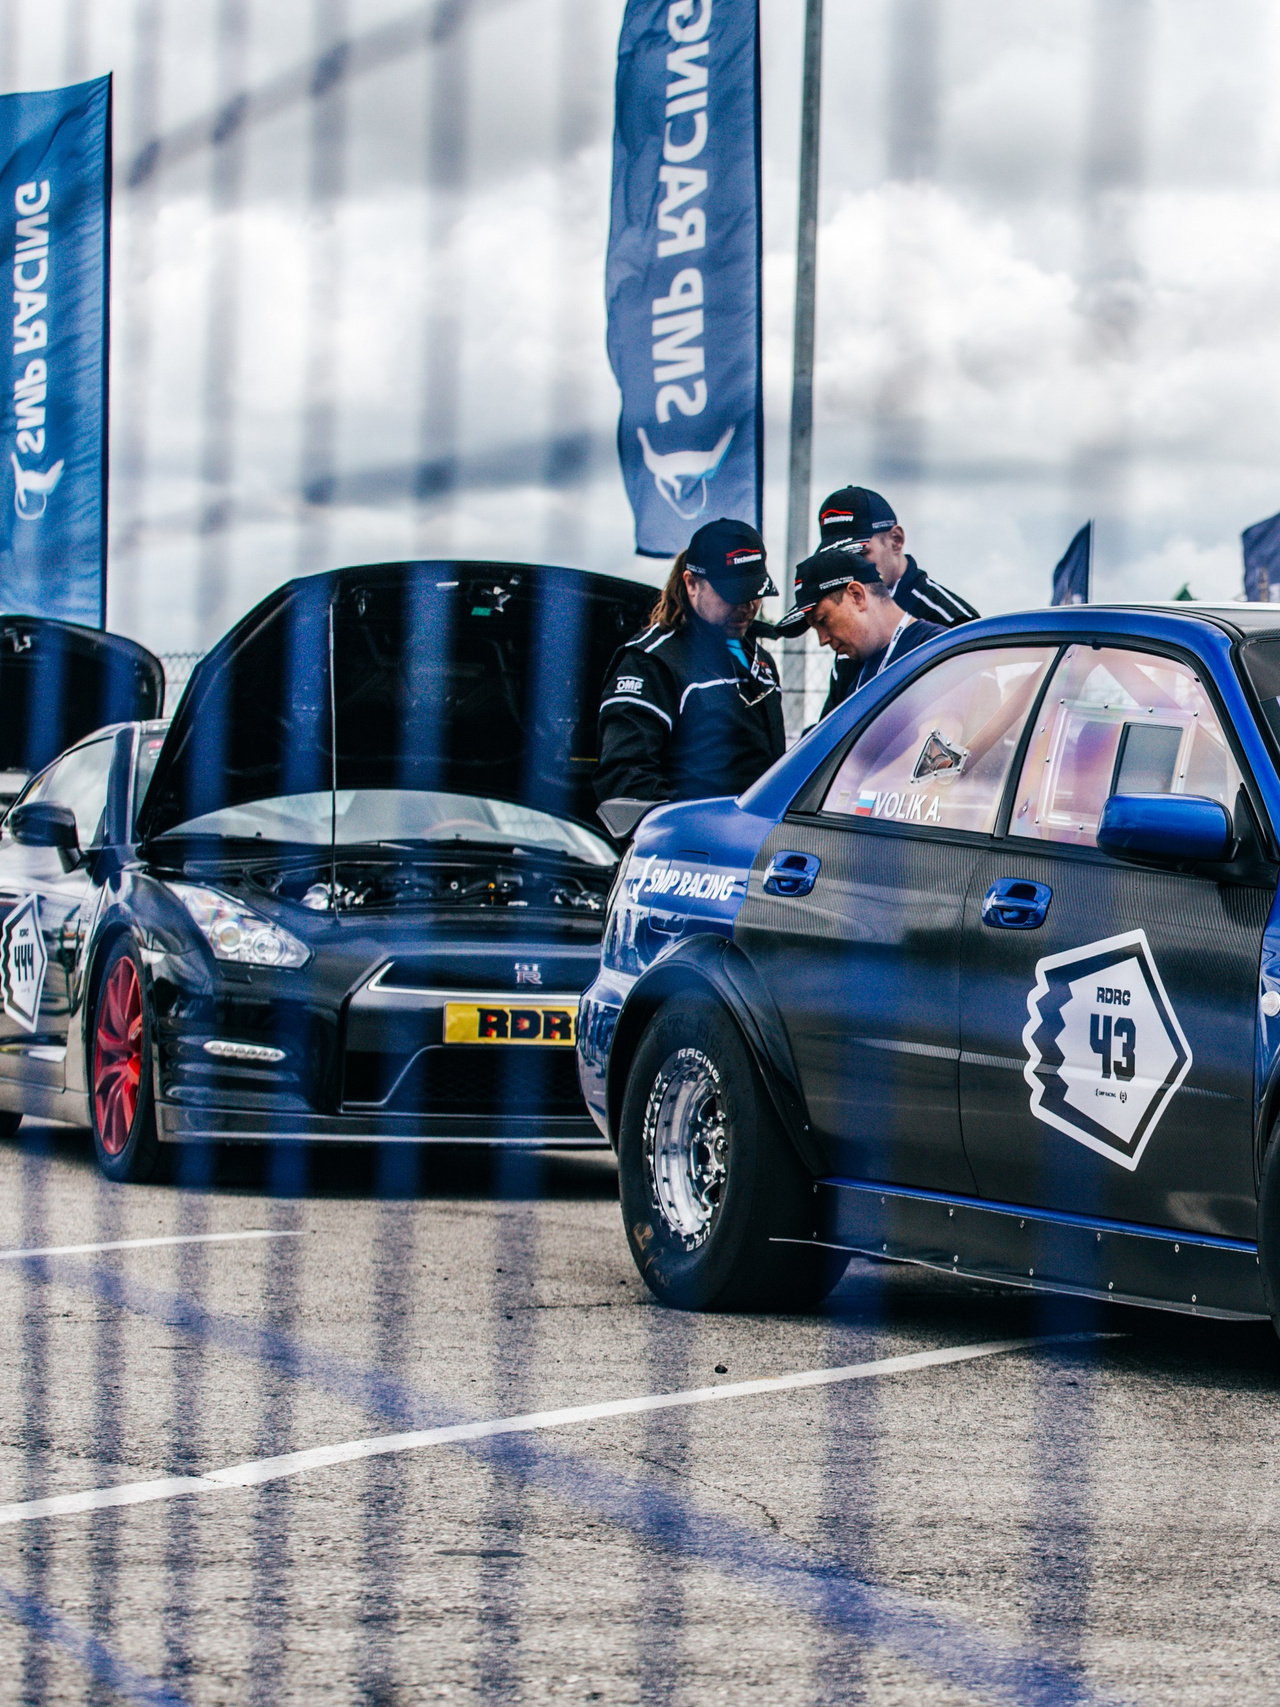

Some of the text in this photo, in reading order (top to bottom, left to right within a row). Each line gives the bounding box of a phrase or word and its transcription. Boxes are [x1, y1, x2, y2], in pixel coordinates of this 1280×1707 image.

[616, 680, 643, 691] OMP
[874, 791, 928, 820] VOLIK
[924, 796, 942, 822] A.
[643, 868, 737, 901] SMP RACING
[14, 943, 35, 982] 444
[1096, 986, 1131, 1006] RDRC
[477, 1008, 579, 1040] RDR
[1089, 1013, 1137, 1082] 43
[677, 1047, 720, 1083] RACING
